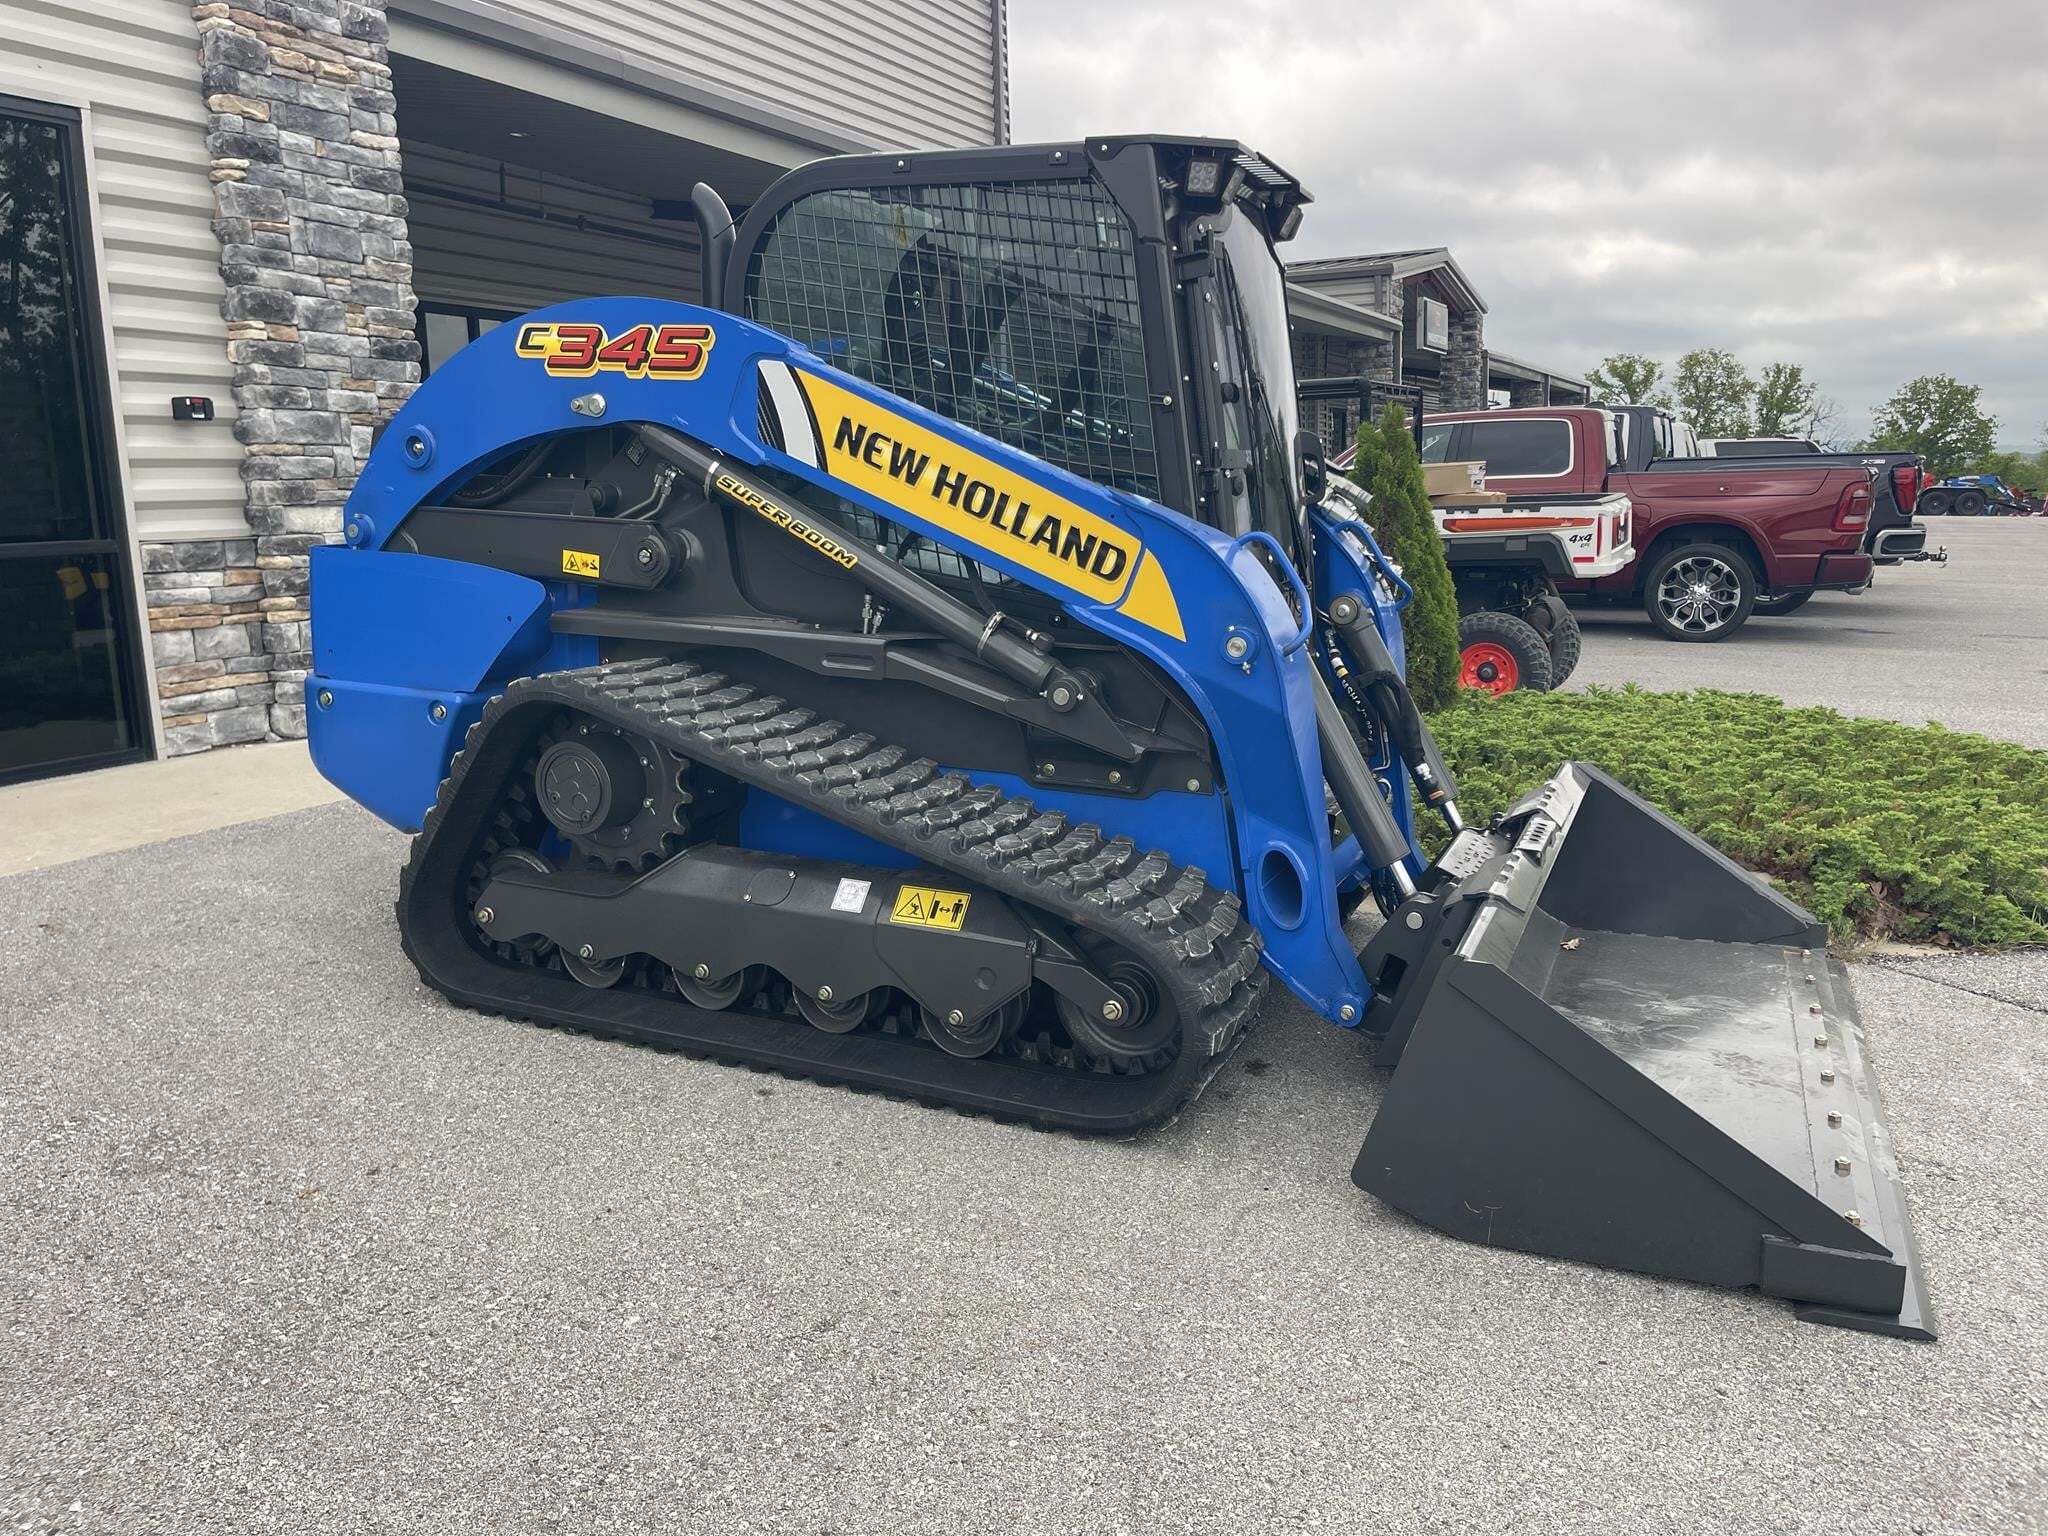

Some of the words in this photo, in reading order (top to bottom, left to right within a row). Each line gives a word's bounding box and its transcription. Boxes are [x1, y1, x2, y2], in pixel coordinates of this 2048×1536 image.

[516, 324, 714, 378] C345
[717, 475, 792, 527] SUPER
[789, 520, 858, 568] BOOM
[832, 415, 930, 487] NEW
[930, 463, 1128, 583] HOLLAND
[1568, 533, 1593, 544] 4x4
